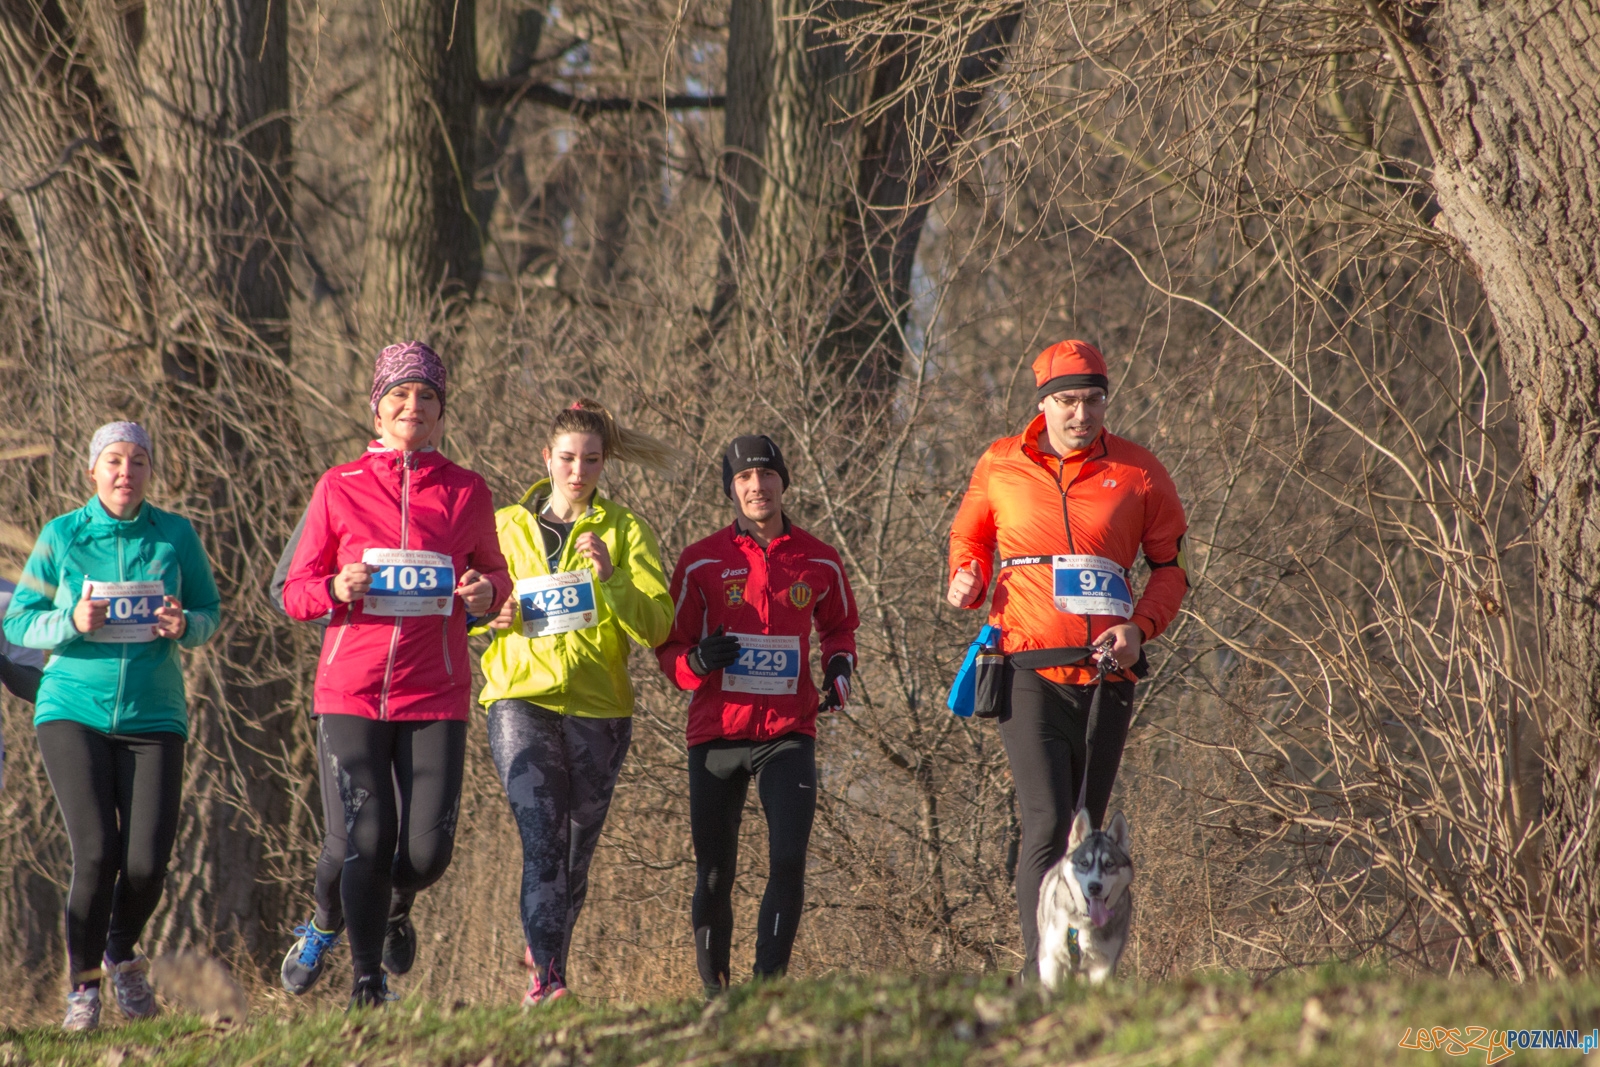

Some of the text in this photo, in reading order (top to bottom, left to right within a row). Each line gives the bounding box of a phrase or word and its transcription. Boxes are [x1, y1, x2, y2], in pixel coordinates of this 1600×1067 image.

[380, 566, 438, 591] 103
[1079, 570, 1113, 592] 97
[532, 587, 580, 612] 428
[738, 649, 788, 672] 429
